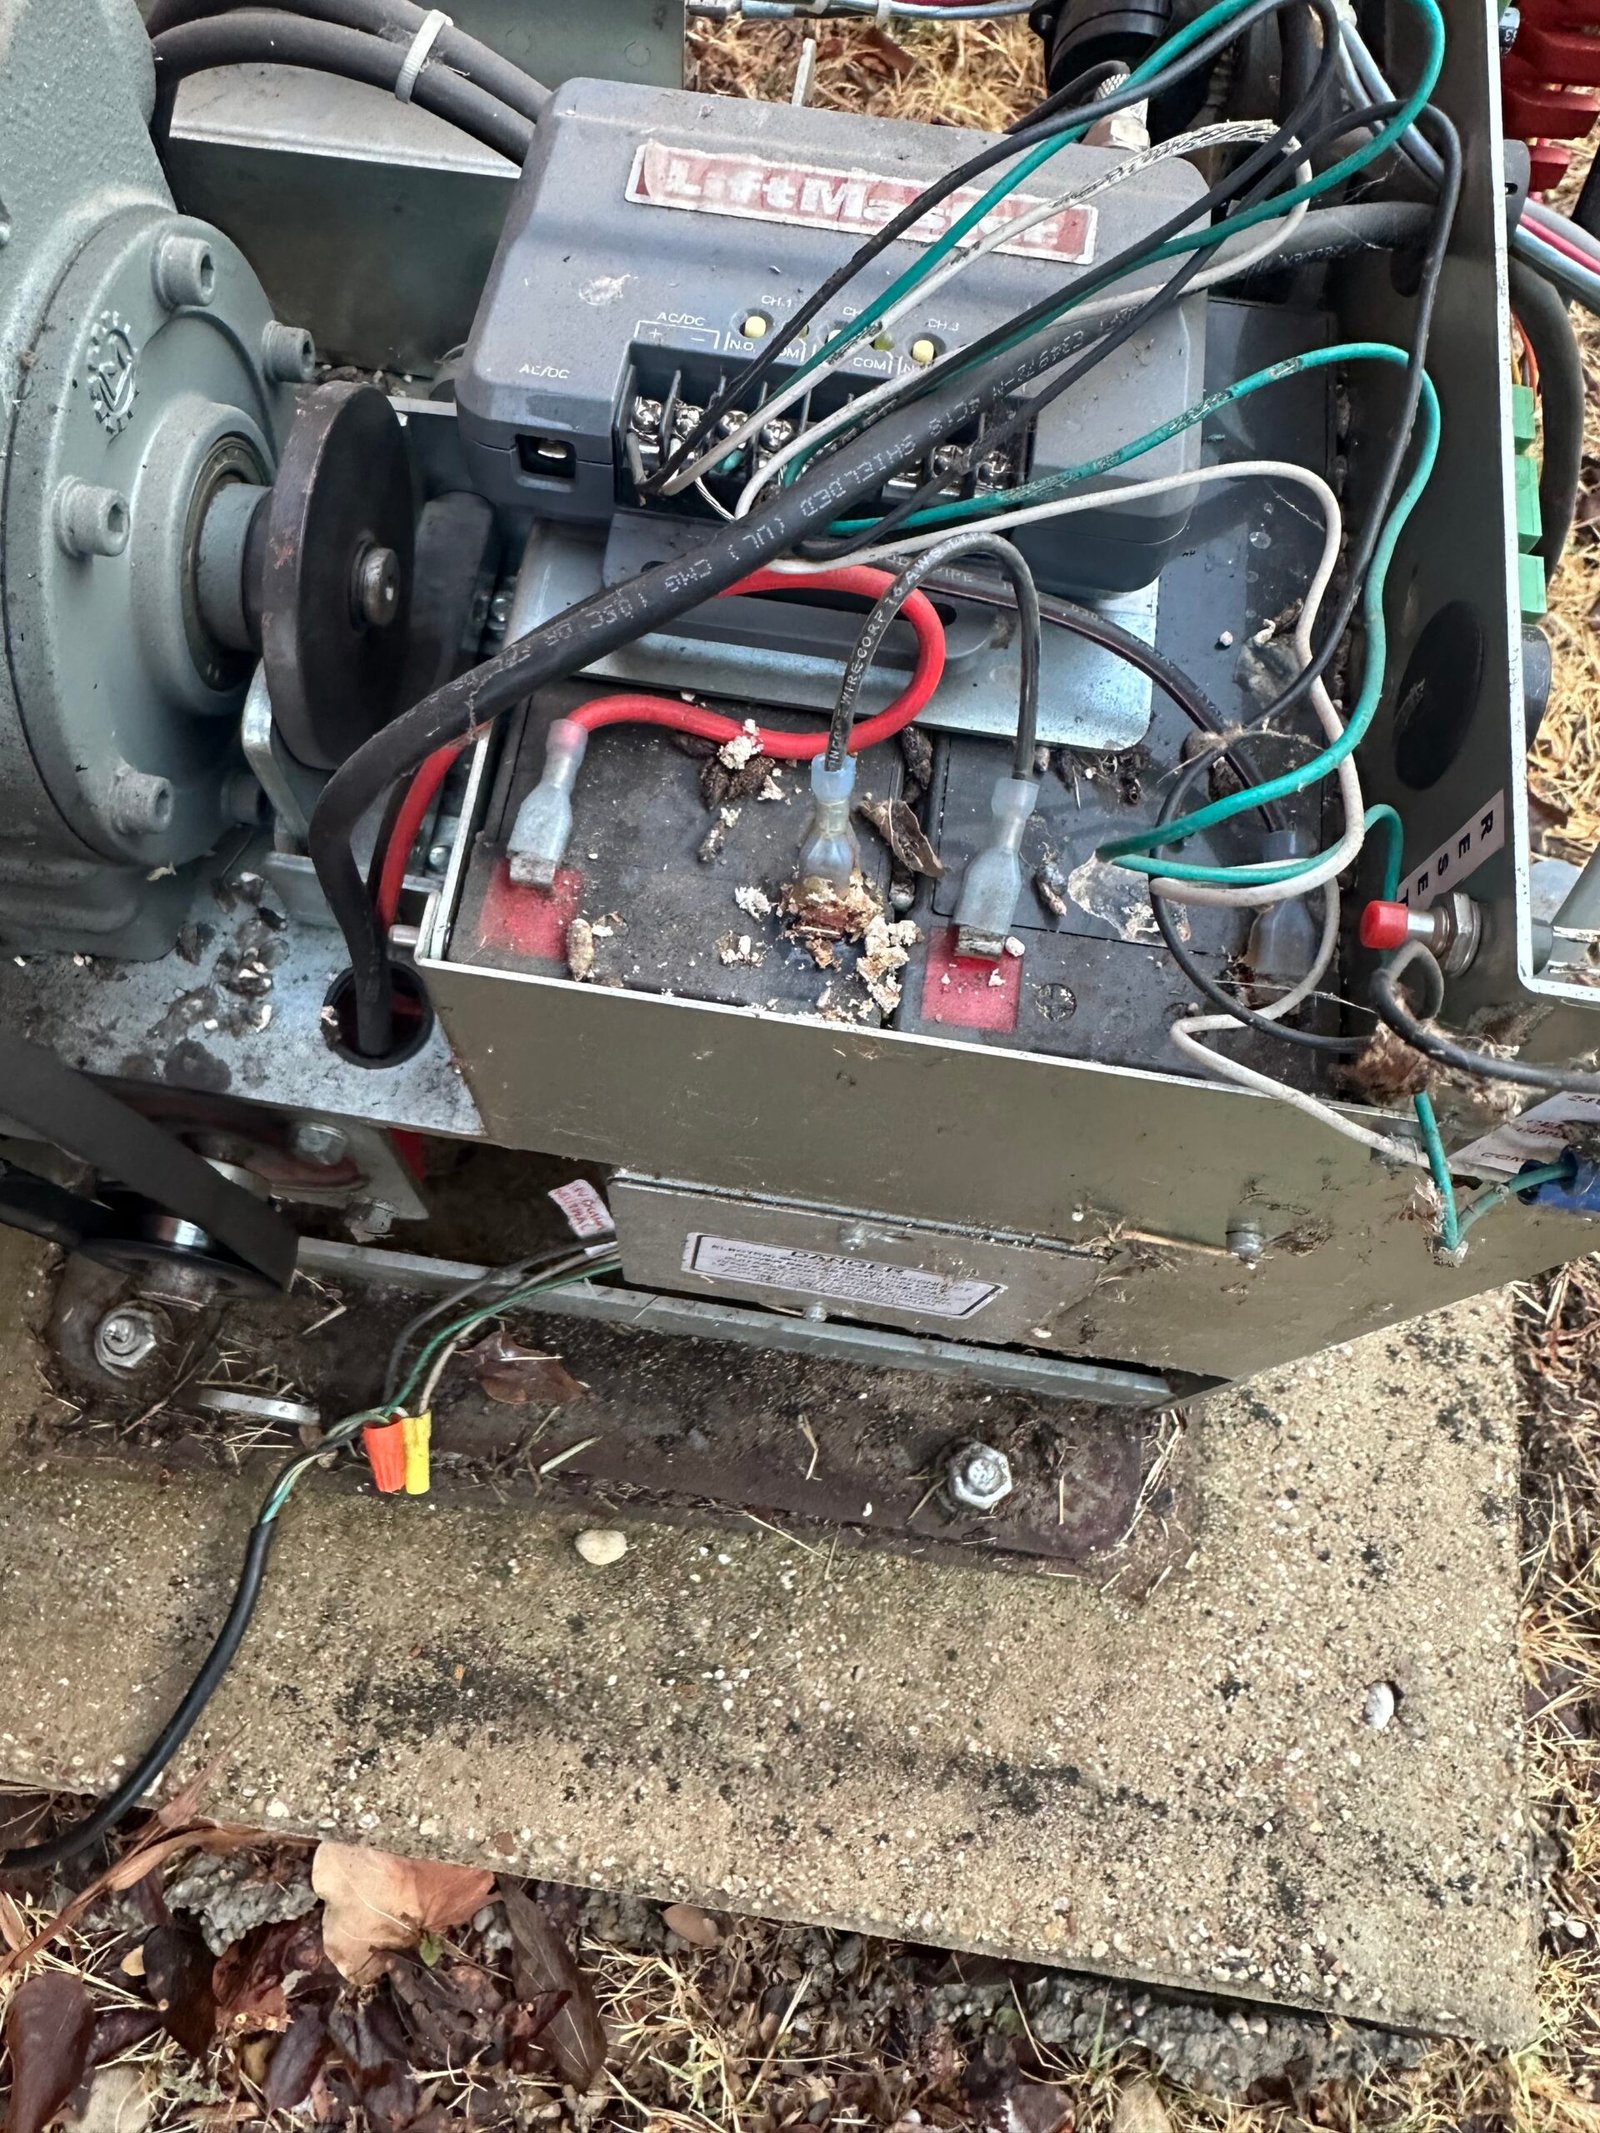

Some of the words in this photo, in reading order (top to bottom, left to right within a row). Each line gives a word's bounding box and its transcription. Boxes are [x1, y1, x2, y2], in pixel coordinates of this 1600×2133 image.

[761, 295, 792, 308] CH.1
[657, 312, 705, 327] AC/DC
[853, 358, 887, 371] COM
[799, 435, 917, 517] SHIELDED
[664, 558, 713, 593] CMG
[1398, 810, 1493, 907] RESET
